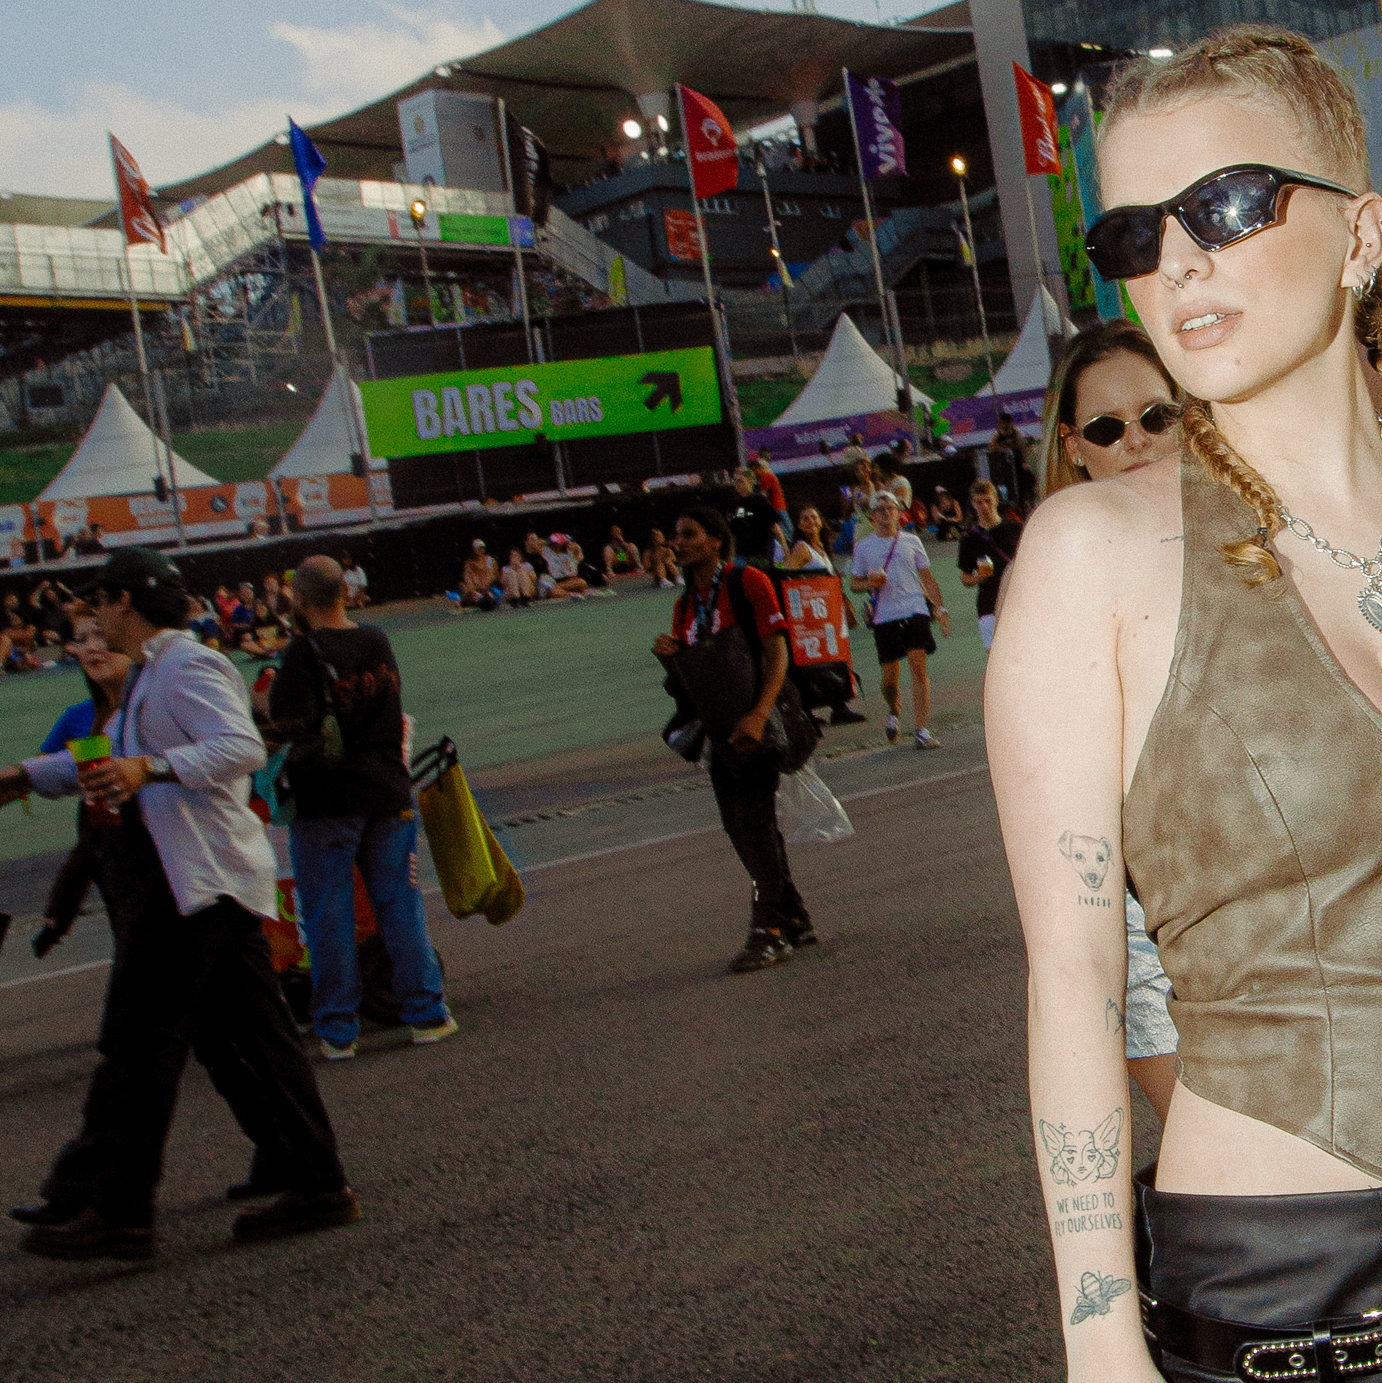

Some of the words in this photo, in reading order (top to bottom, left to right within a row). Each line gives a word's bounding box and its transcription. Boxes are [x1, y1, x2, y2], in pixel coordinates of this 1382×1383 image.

[869, 106, 897, 174] vivo
[412, 379, 543, 440] BARES
[550, 396, 604, 426] BARS
[804, 636, 822, 658] 12
[1056, 1198, 1069, 1213] WE
[1072, 1194, 1099, 1211] NEED
[1103, 1192, 1115, 1208] TO
[1067, 1213, 1123, 1232] OURSELVES
